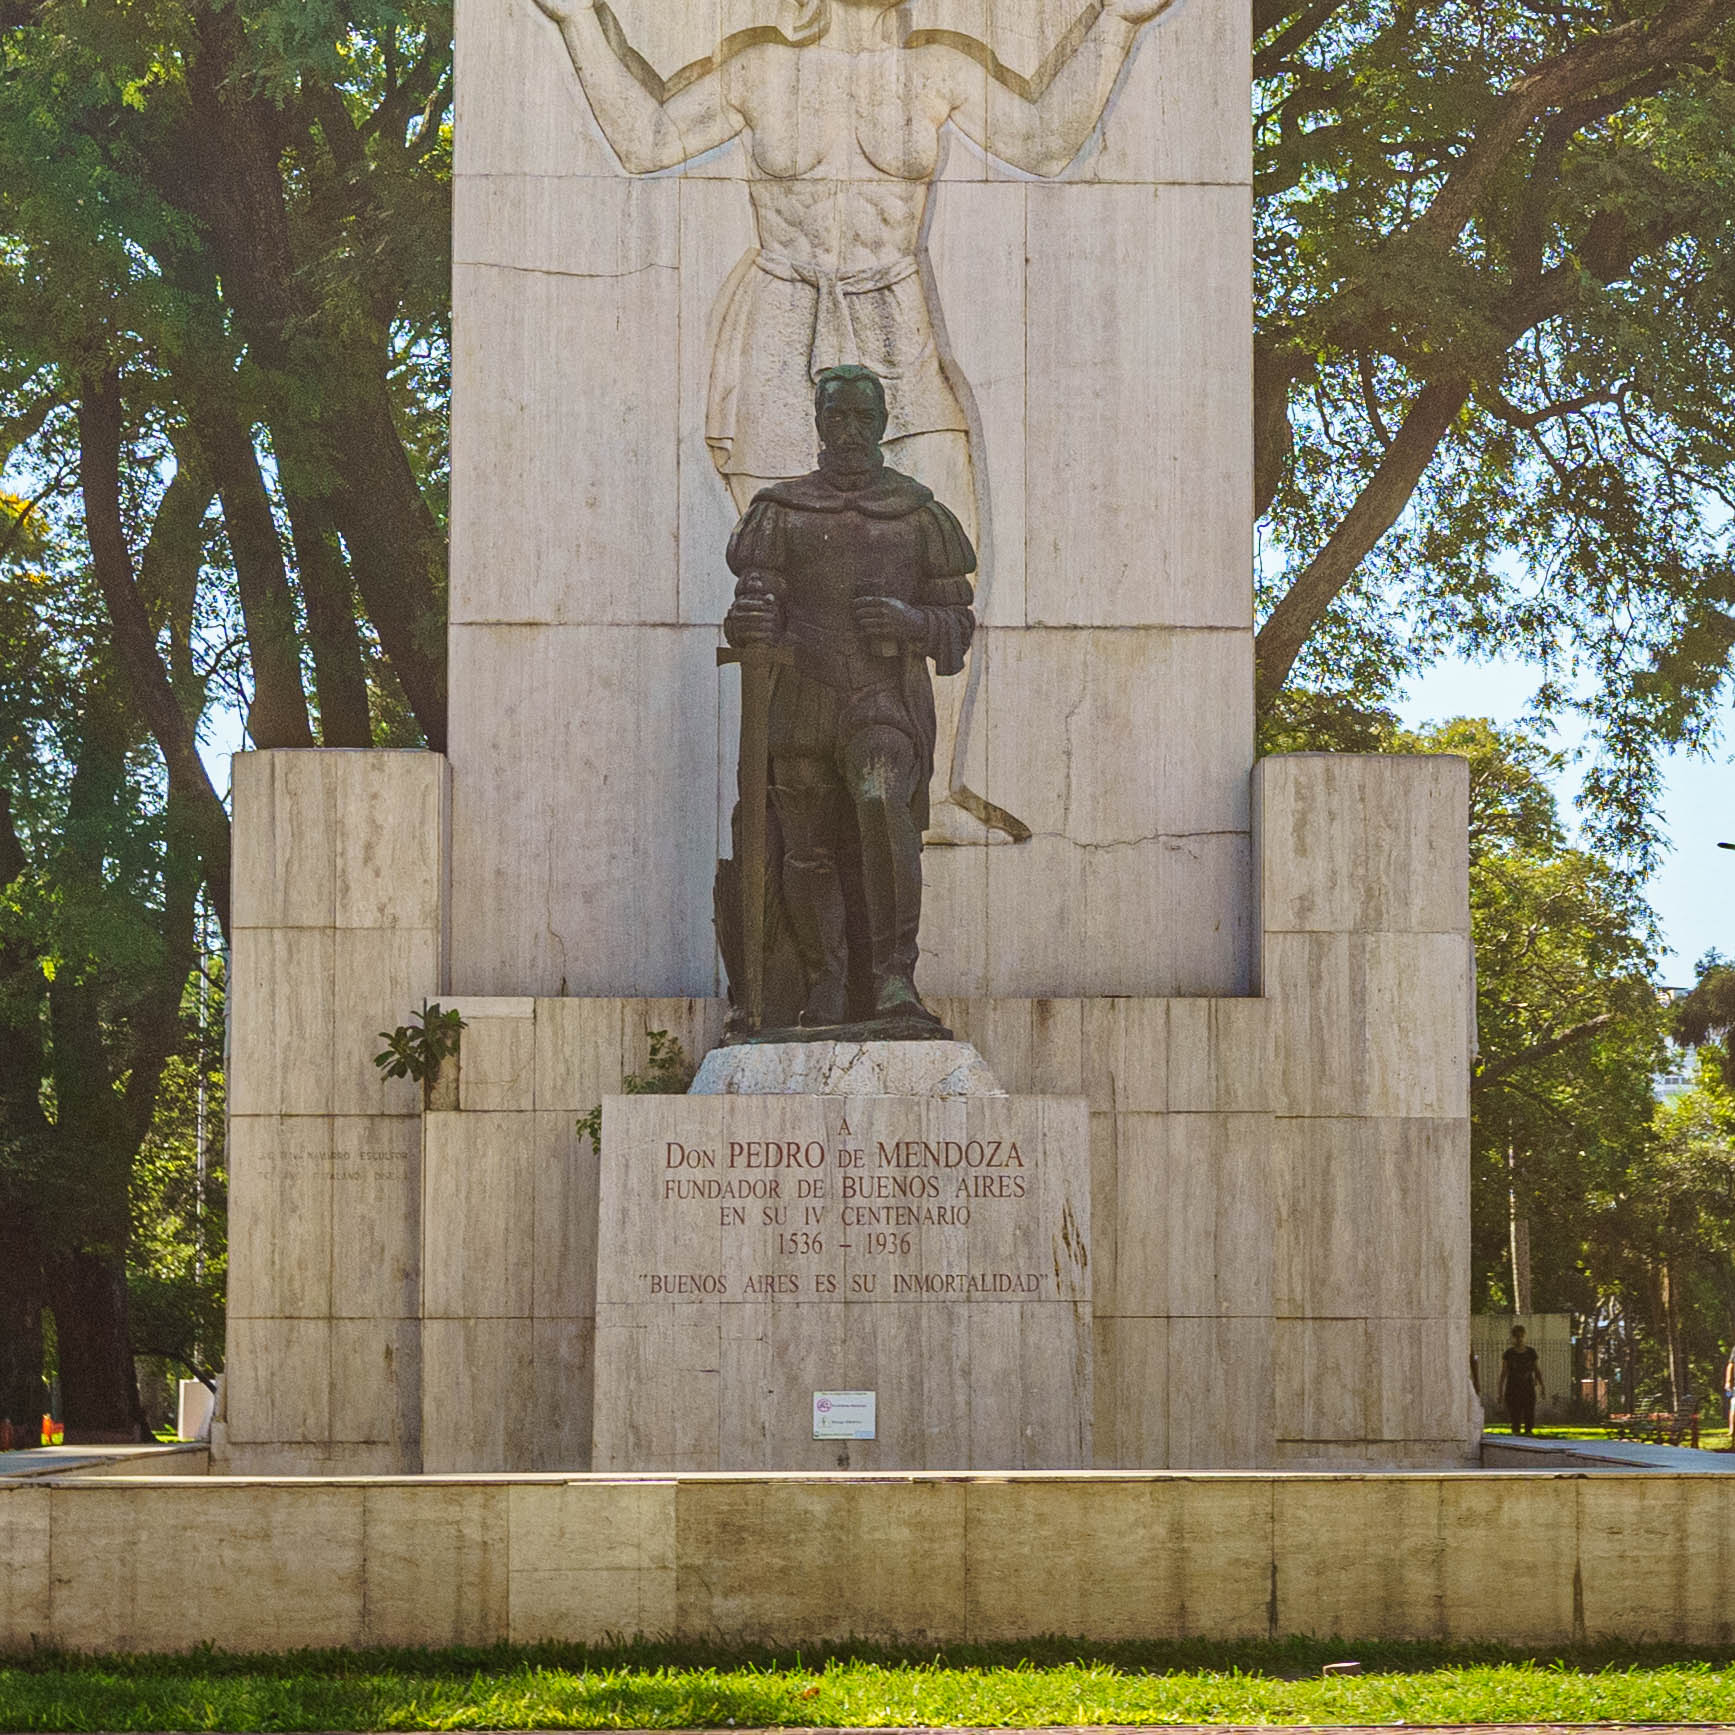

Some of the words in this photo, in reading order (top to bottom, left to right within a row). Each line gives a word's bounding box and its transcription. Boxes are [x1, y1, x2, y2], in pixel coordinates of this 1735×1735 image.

[837, 1117, 852, 1136] A
[728, 1140, 825, 1169] PEDRO
[837, 1148, 865, 1169] DE
[877, 1140, 1025, 1169] MENDOZA
[664, 1179, 782, 1200] FUNDADOR
[797, 1179, 825, 1199] DE
[841, 1175, 940, 1199] BUENOS
[955, 1175, 1026, 1199] AIRES
[719, 1206, 746, 1226] EN
[762, 1206, 788, 1226] SU
[804, 1206, 825, 1226] IV
[841, 1205, 971, 1226] CENTENARIO
[779, 1231, 824, 1255] 1536
[867, 1231, 913, 1255] 1936
[743, 1273, 800, 1294] AIRES
[815, 1273, 837, 1293] ES
[851, 1273, 877, 1293] SU
